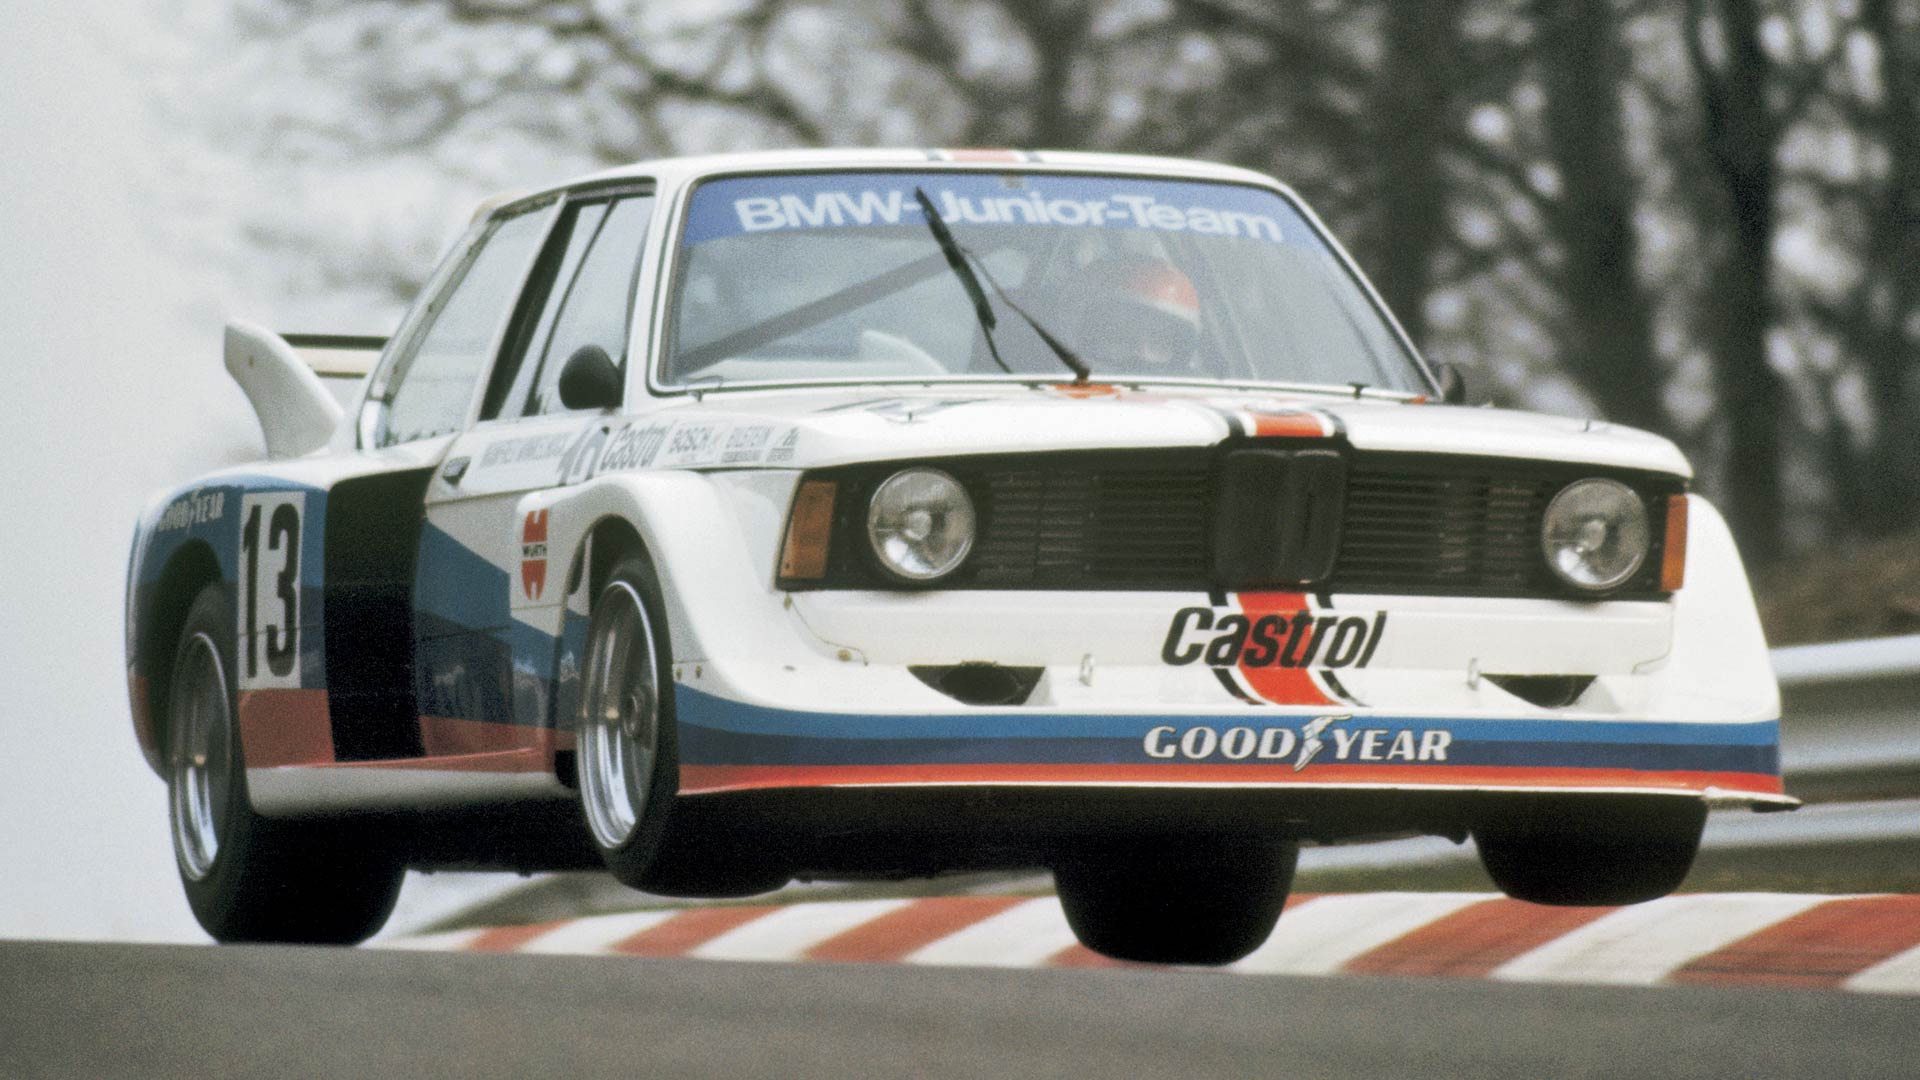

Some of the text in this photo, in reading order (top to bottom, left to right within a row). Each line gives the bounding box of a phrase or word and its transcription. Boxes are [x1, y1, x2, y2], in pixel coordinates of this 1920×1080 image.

[244, 503, 299, 678] 13
[1161, 606, 1387, 669] Castrol
[1143, 725, 1452, 761] GOOD YEAR
